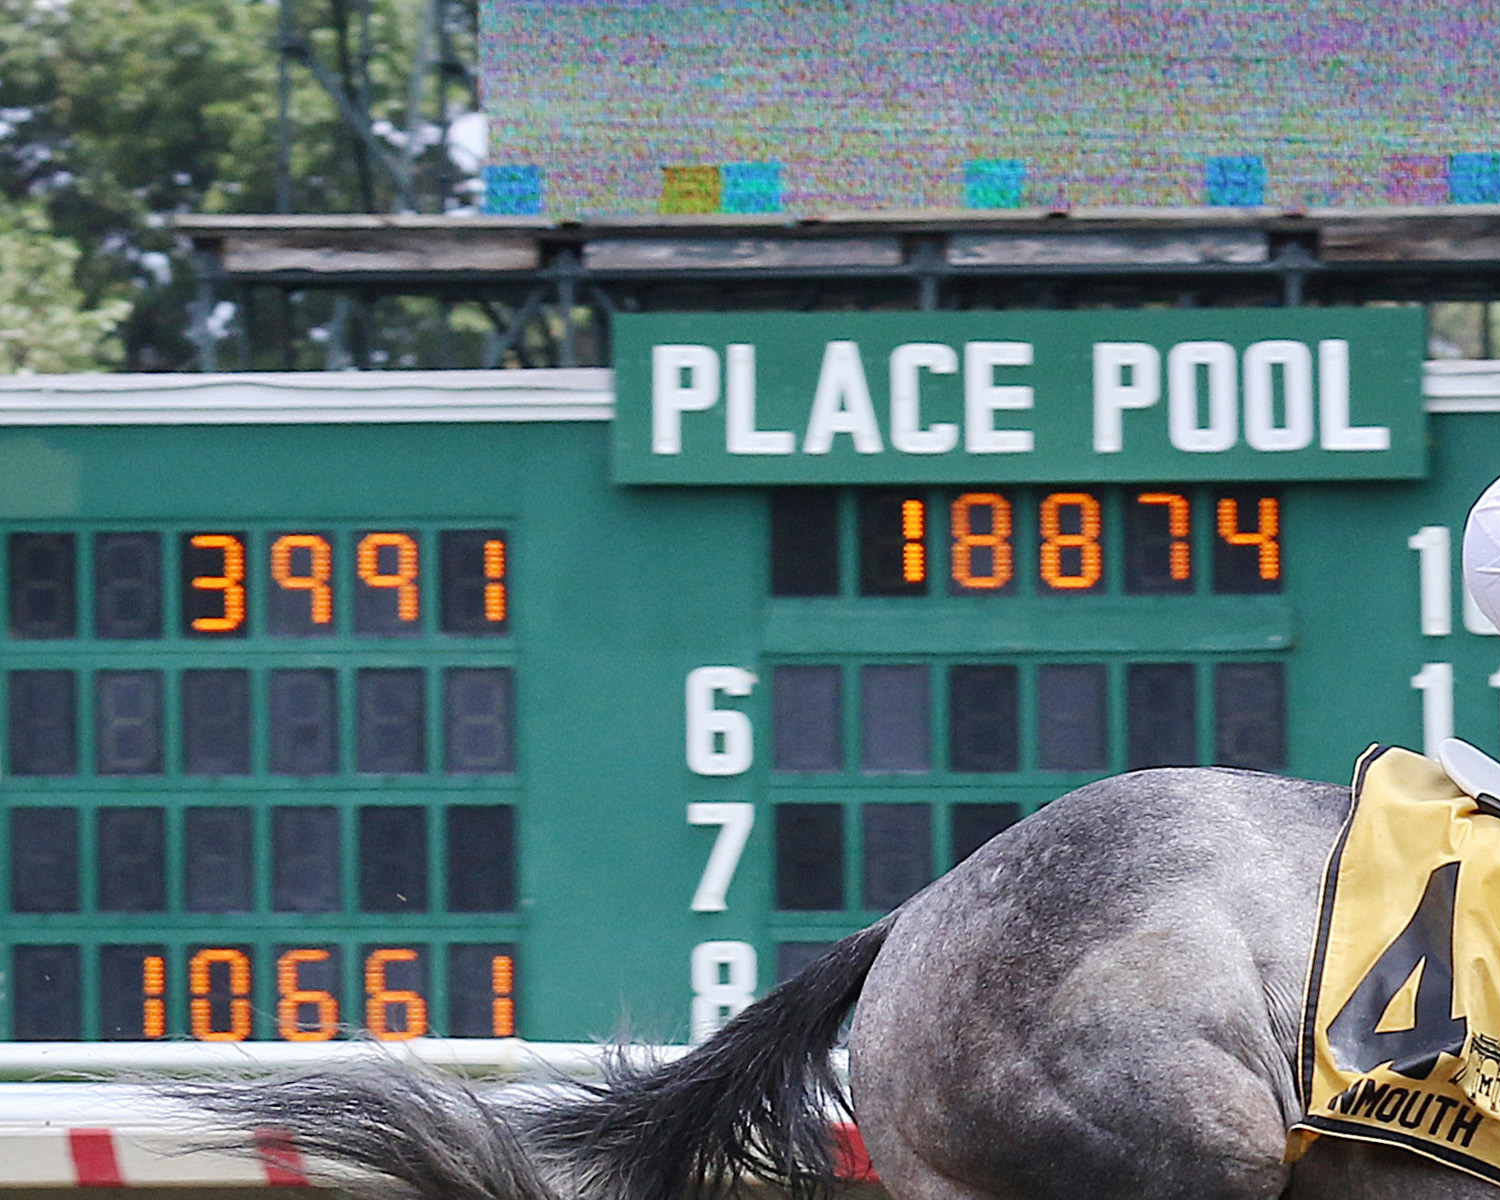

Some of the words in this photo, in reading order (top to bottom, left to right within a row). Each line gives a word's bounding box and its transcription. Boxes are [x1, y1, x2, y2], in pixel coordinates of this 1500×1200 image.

[652, 340, 1035, 455] PLACE
[1092, 339, 1391, 453] POOL
[191, 533, 507, 632] 3991
[902, 492, 1280, 590] 18874
[685, 665, 758, 776] 6
[686, 802, 756, 912] 7
[142, 948, 514, 1043] 10661
[690, 940, 757, 1044] 8
[1326, 861, 1468, 1080] 4
